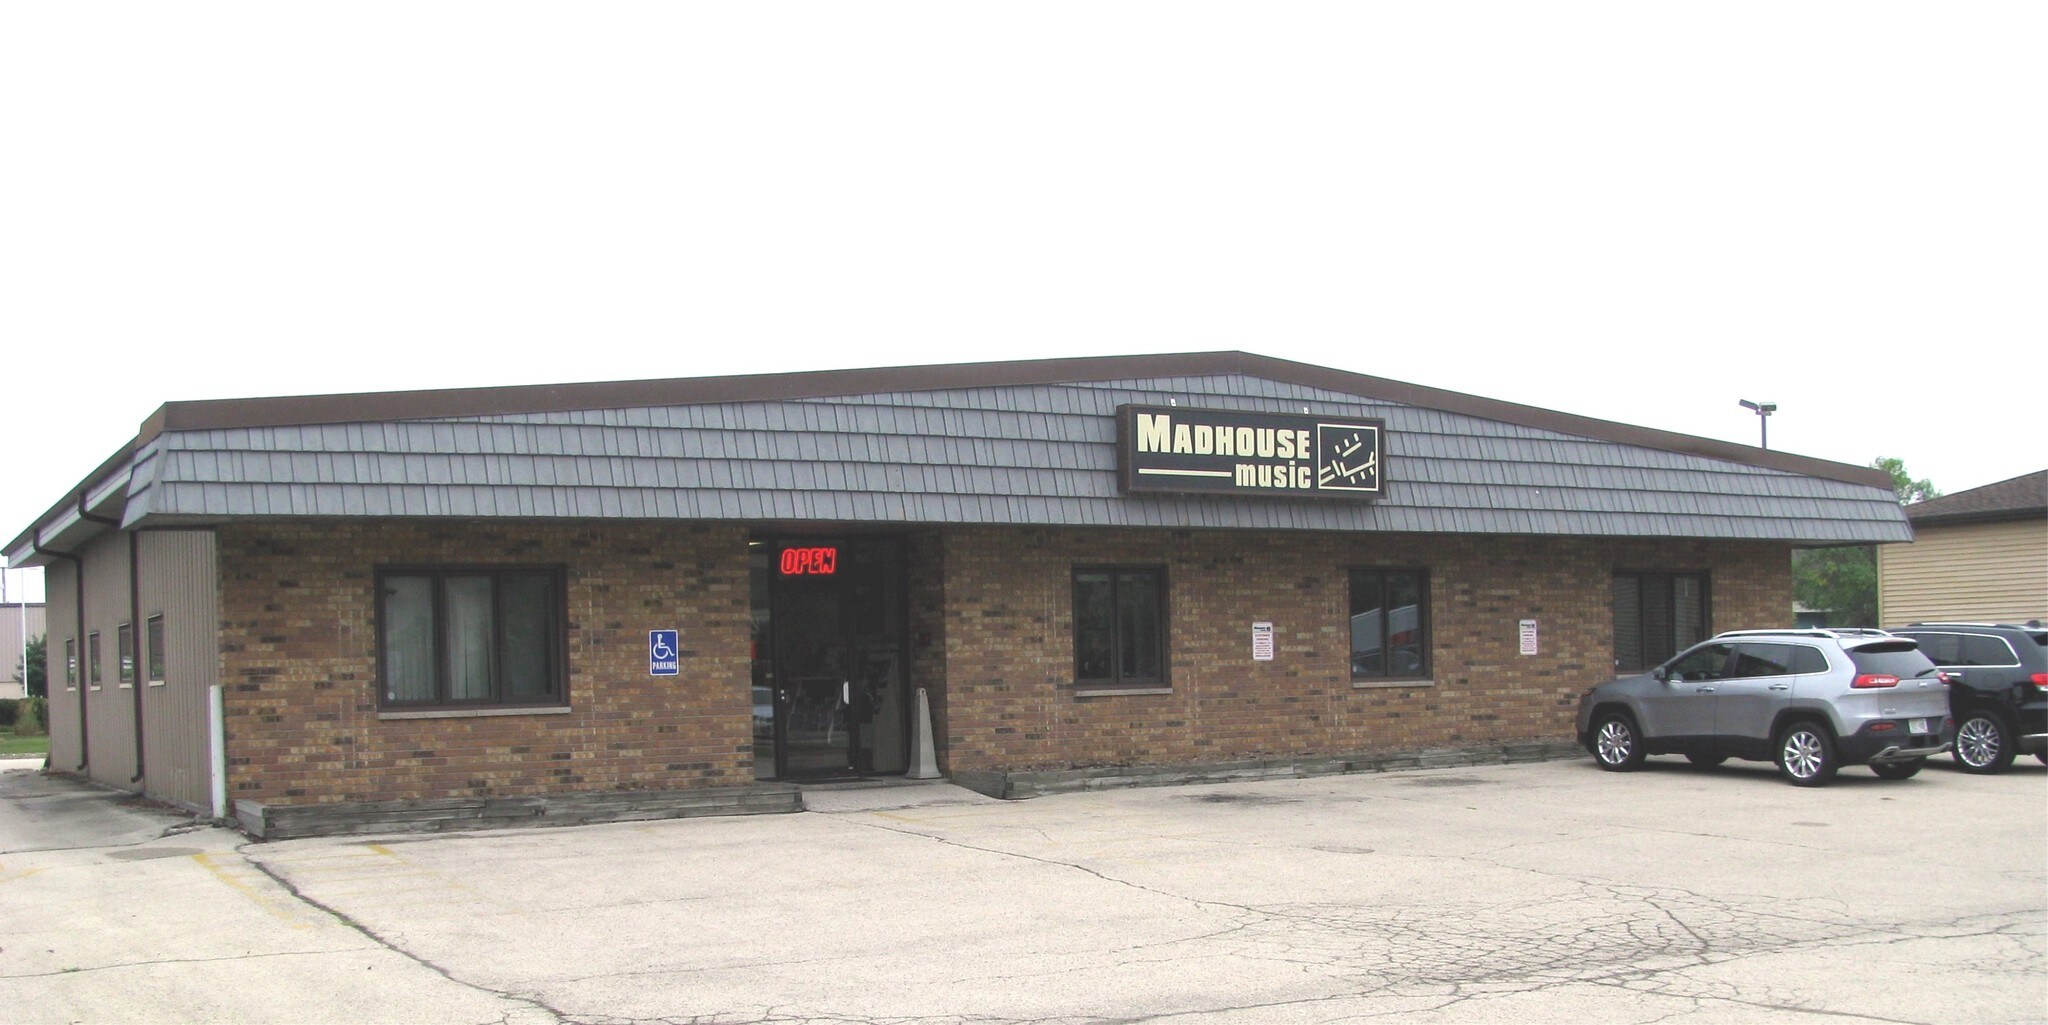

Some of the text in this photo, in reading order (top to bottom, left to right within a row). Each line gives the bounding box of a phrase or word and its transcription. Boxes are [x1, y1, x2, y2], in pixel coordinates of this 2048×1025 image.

[1137, 413, 1310, 459] MADHOUSE
[1236, 460, 1311, 489] music
[780, 547, 836, 575] OPEN
[652, 661, 677, 670] PARKING
